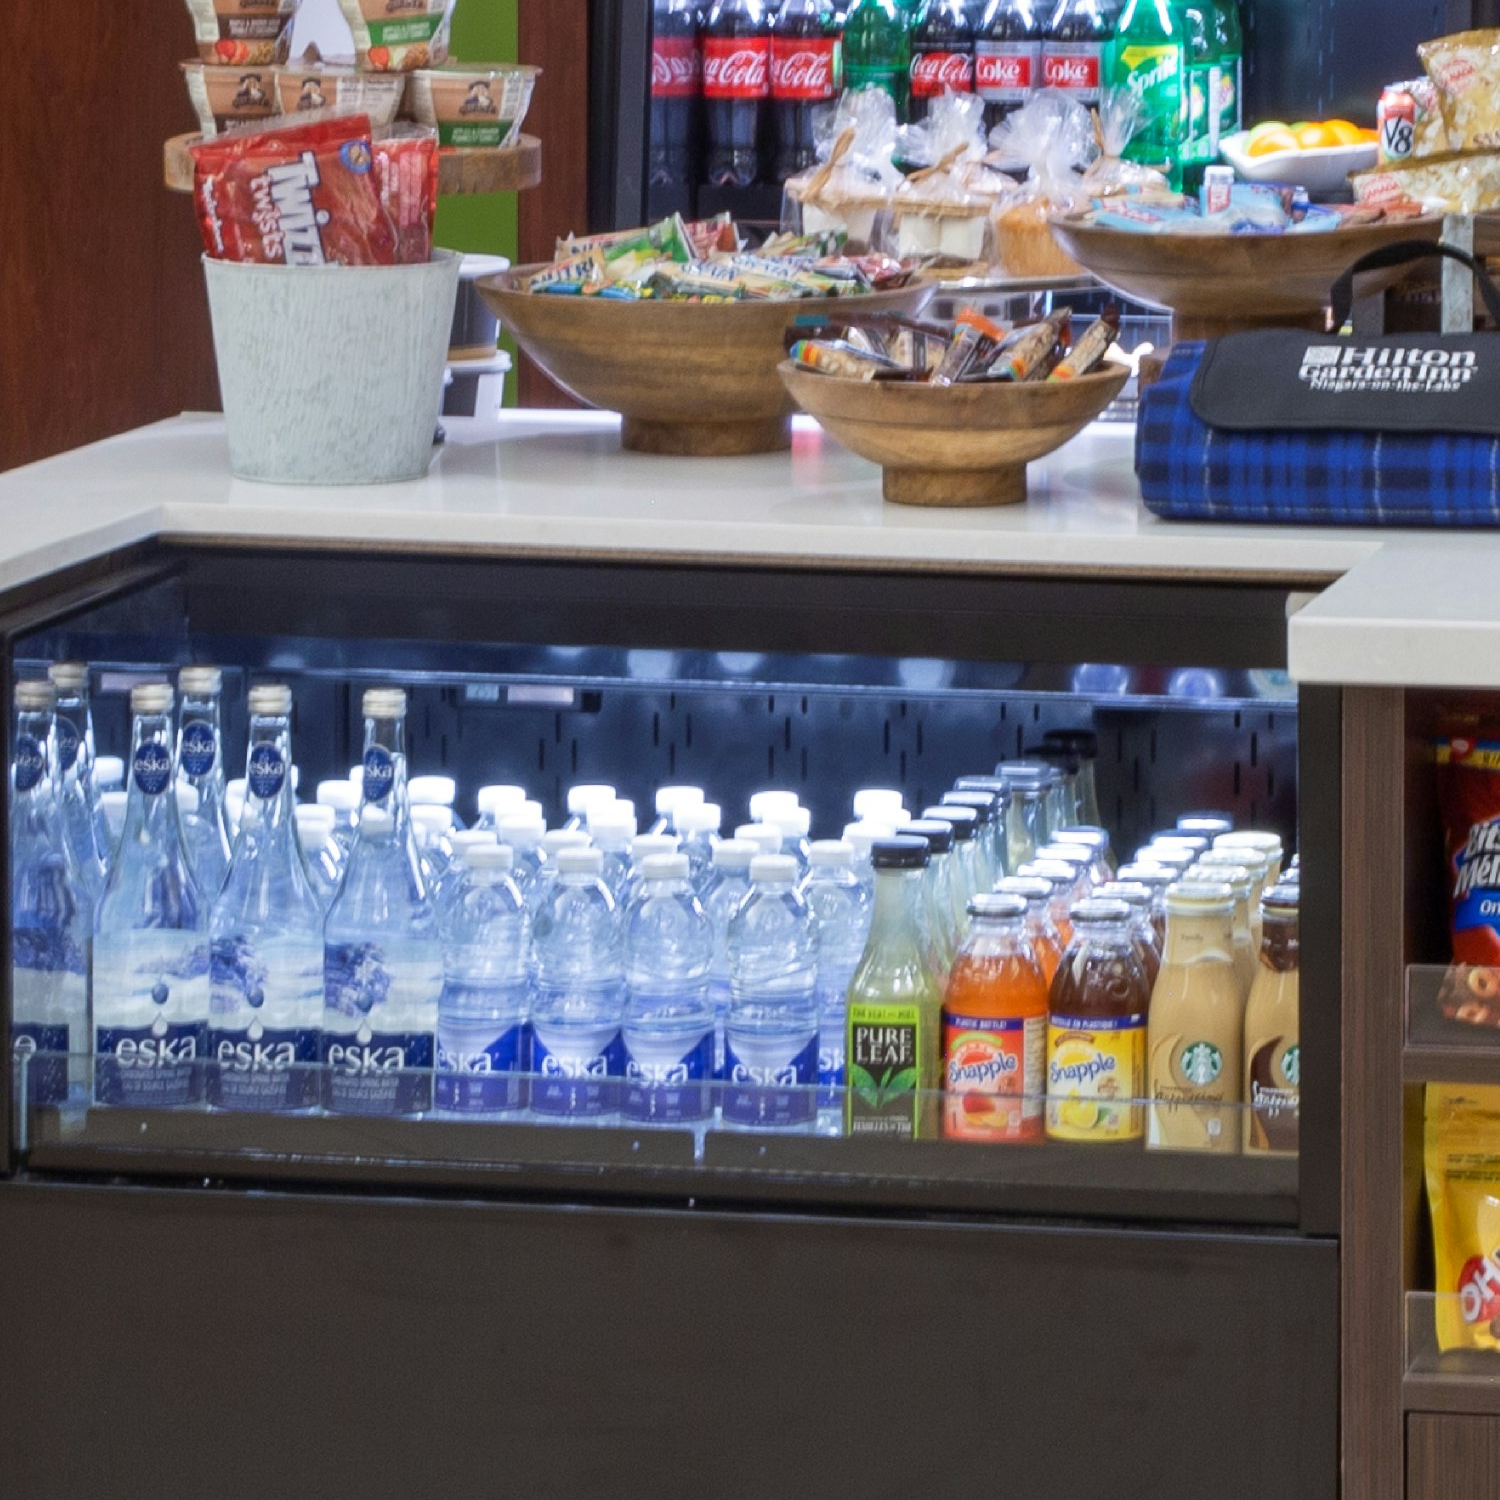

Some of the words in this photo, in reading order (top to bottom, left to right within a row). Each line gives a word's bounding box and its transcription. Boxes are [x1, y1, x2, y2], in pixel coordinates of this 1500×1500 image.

[1383, 116, 1414, 155] V8
[1341, 347, 1477, 366] Hilton
[1299, 364, 1415, 382] Garden
[1418, 364, 1473, 382] Inn
[856, 1027, 912, 1047] PURE
[115, 1038, 197, 1066] eska
[217, 1038, 296, 1069] eska
[328, 1042, 406, 1077] eska
[541, 1051, 609, 1080] eska
[856, 1046, 912, 1066] LEAF
[625, 1058, 691, 1088] eska
[731, 1062, 798, 1088] eska
[948, 1051, 1018, 1084] Snapple
[1049, 1051, 1116, 1085] Snapple
